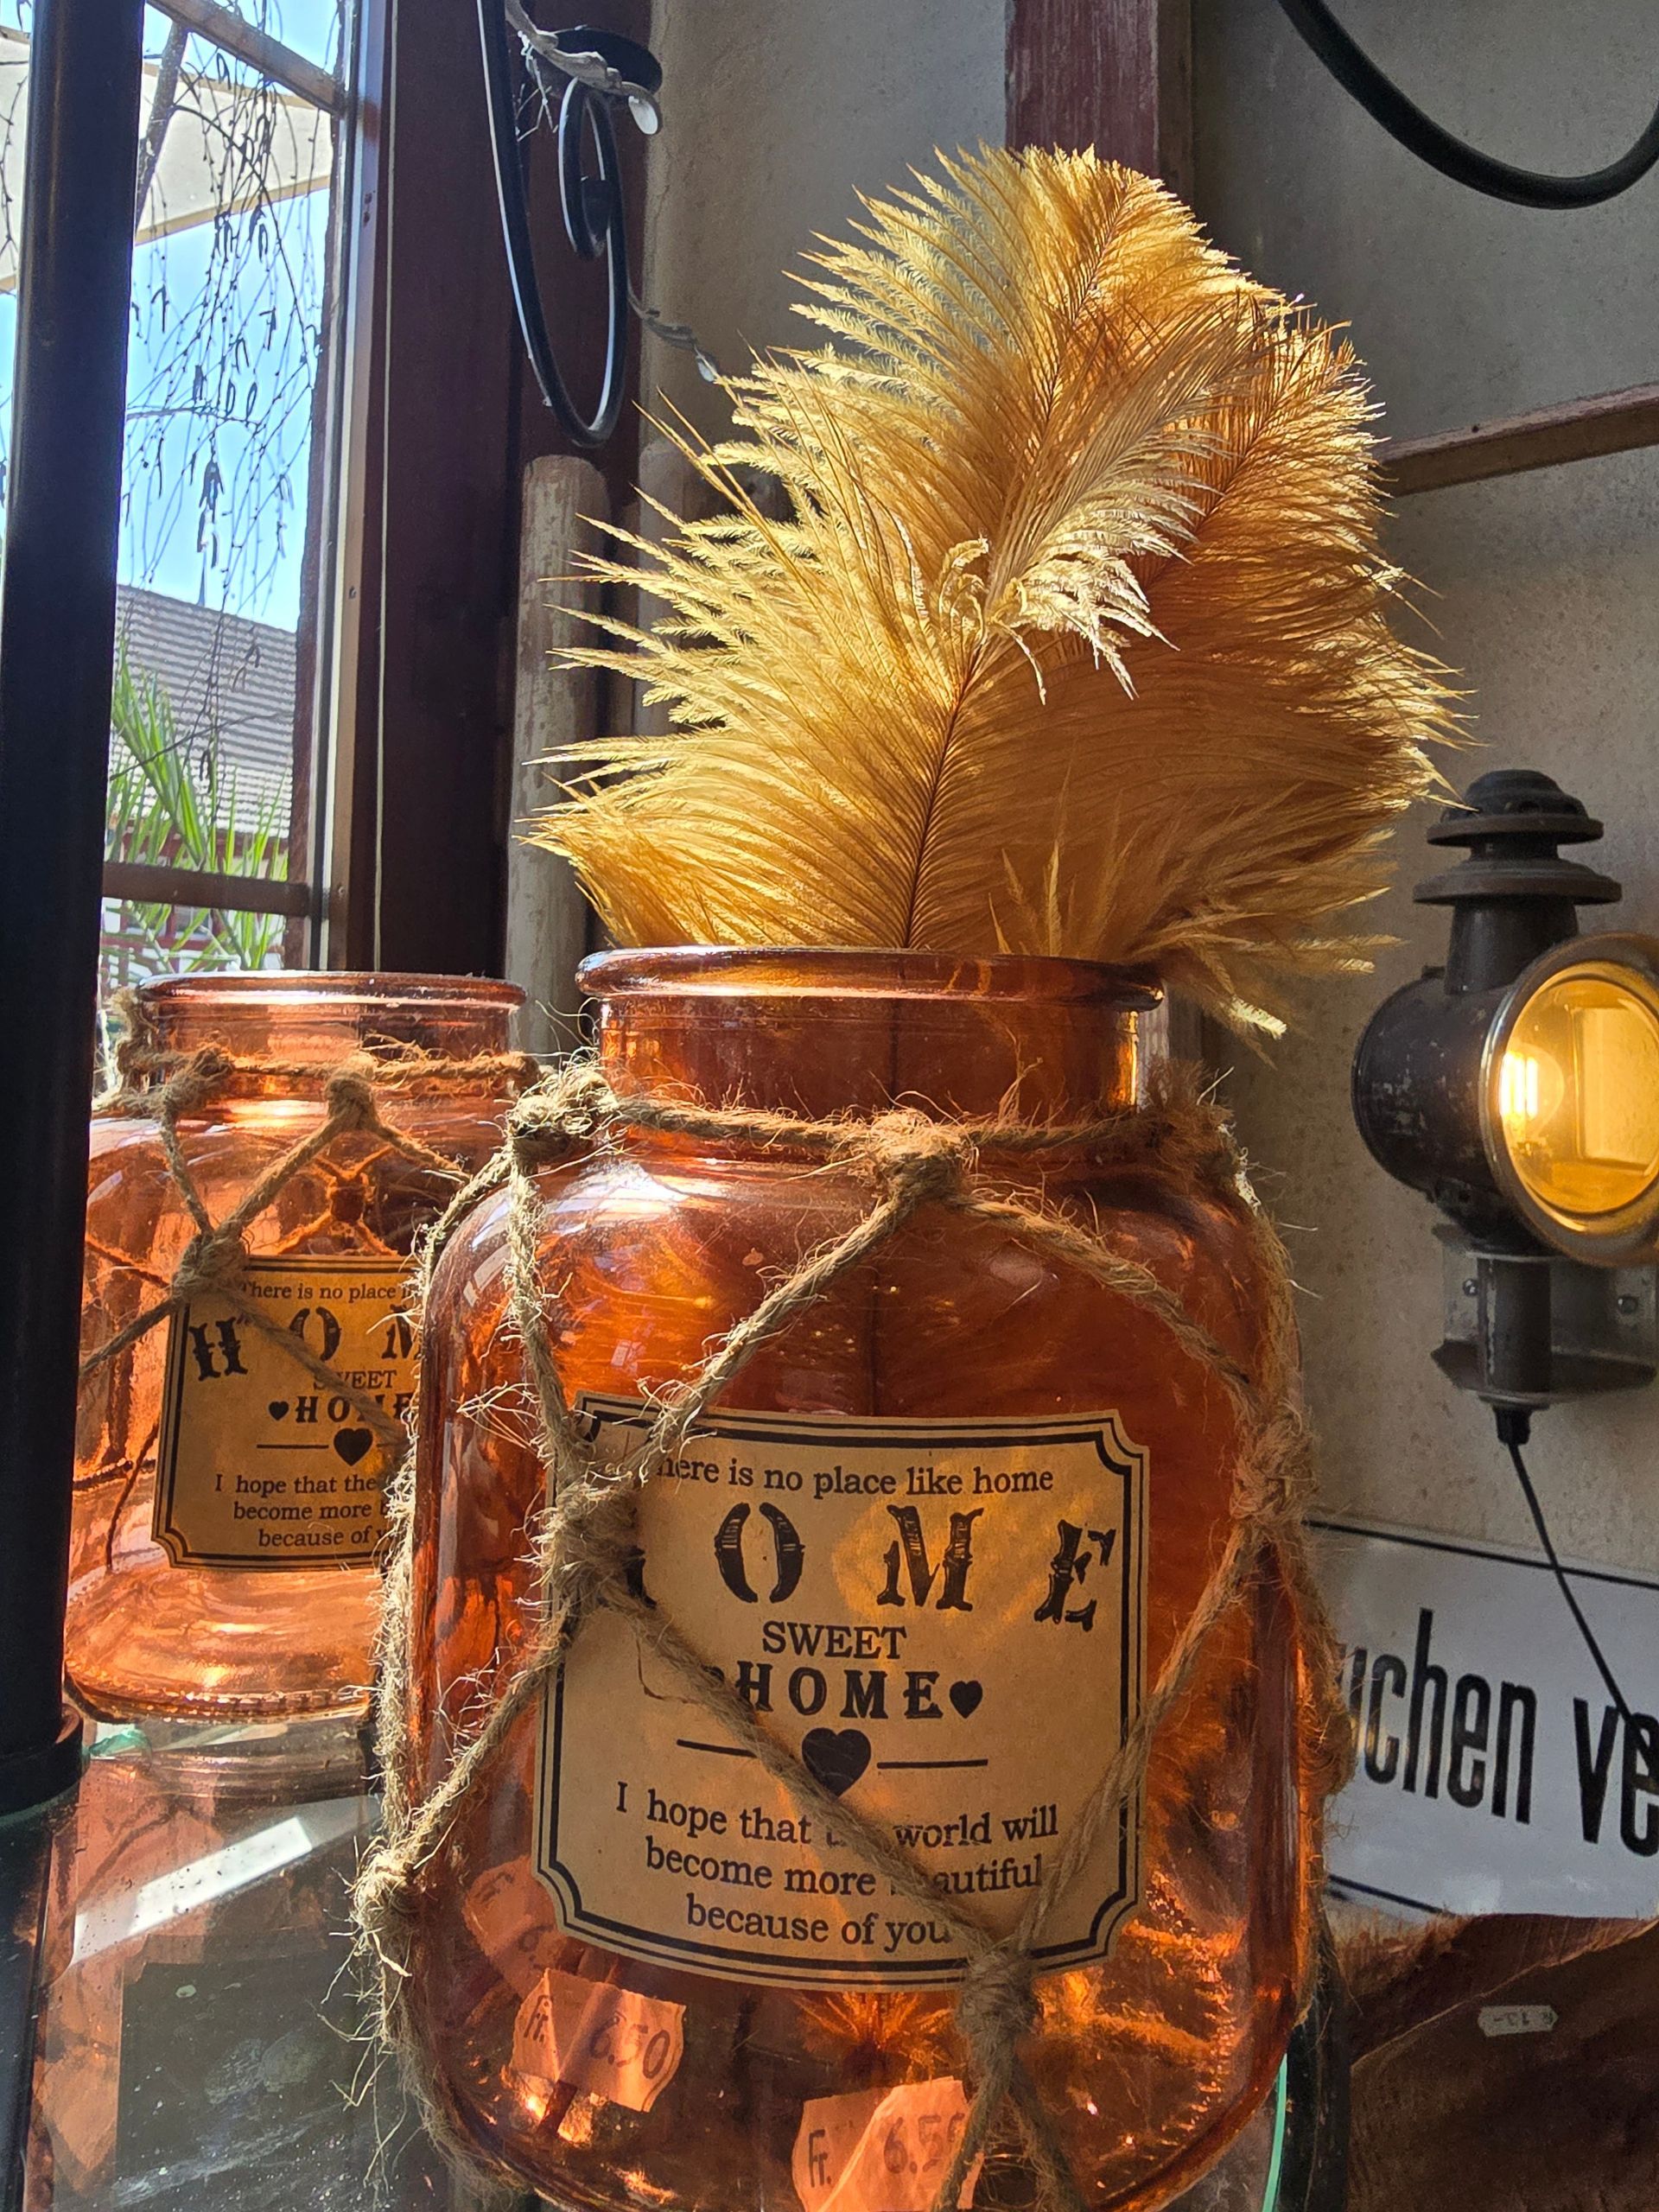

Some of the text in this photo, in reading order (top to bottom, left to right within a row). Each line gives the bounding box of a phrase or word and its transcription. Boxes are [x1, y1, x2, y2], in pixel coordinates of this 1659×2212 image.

[241, 1282, 291, 1299] here
[297, 1283, 313, 1299] is
[320, 1287, 343, 1300] no
[349, 1284, 397, 1303] place
[214, 1474, 377, 1497] I hope that the
[656, 1458, 1053, 1500] here is no place like home
[233, 1501, 313, 1521] become
[319, 1503, 372, 1520] more
[258, 1529, 344, 1548] because
[351, 1525, 372, 1545] of
[622, 1502, 1116, 1632] OME
[761, 1619, 907, 1660] SWEET
[734, 1660, 944, 1719] HOME
[616, 1781, 628, 1813] I
[646, 1789, 728, 1839] hope
[740, 1807, 812, 1845] that
[893, 1812, 992, 1848] world
[1001, 1803, 1059, 1842] will
[645, 1834, 772, 1890] become
[784, 1868, 876, 1896] more
[890, 1853, 1042, 1897] autiful
[686, 1892, 954, 1954] because of you
